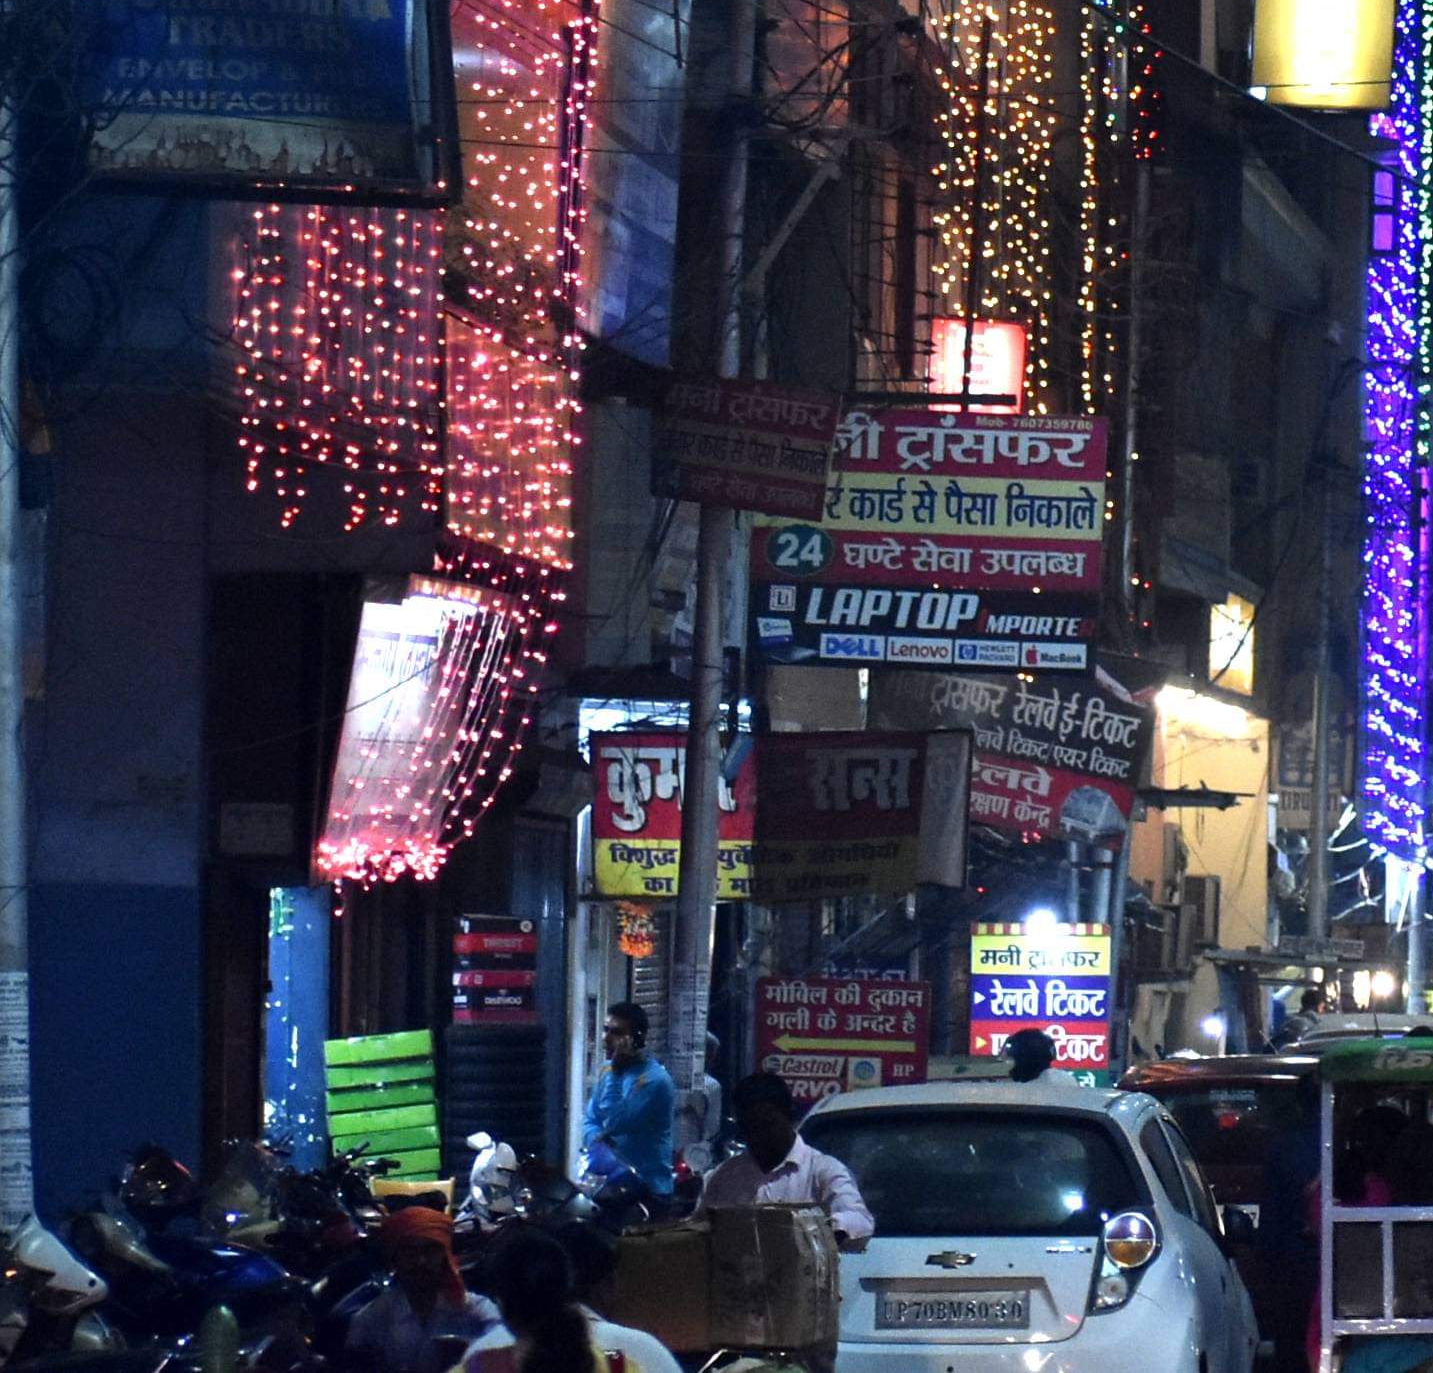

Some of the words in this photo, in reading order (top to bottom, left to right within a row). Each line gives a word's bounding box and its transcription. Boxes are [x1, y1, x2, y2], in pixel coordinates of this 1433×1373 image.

[895, 414, 1092, 471] ट्रांसफर
[849, 478, 907, 524] कार्ड
[911, 480, 938, 524] से
[944, 479, 998, 526] पैसा
[1005, 482, 1098, 530] निकाले
[775, 532, 824, 567] 24
[843, 538, 906, 571] घण्टे
[911, 537, 973, 574] सेवा
[980, 548, 1088, 578] उपलब्ध
[804, 587, 980, 630] LAPTOP
[825, 636, 881, 657] DELL
[890, 640, 949, 659] Lenovo
[1041, 652, 1083, 663] MacBook
[1012, 680, 1060, 731] रेलवे
[642, 876, 675, 894] का
[980, 945, 1021, 968] मनी
[834, 981, 861, 1006] की
[867, 988, 924, 1012] दुकान
[989, 979, 1039, 1016] रेलवे
[1045, 979, 1107, 1017] टिकट
[766, 1007, 811, 1030] गली
[816, 1008, 838, 1031] के
[844, 1013, 897, 1034] अन्दर
[901, 1009, 917, 1034] है
[782, 1056, 839, 1075] Castrol
